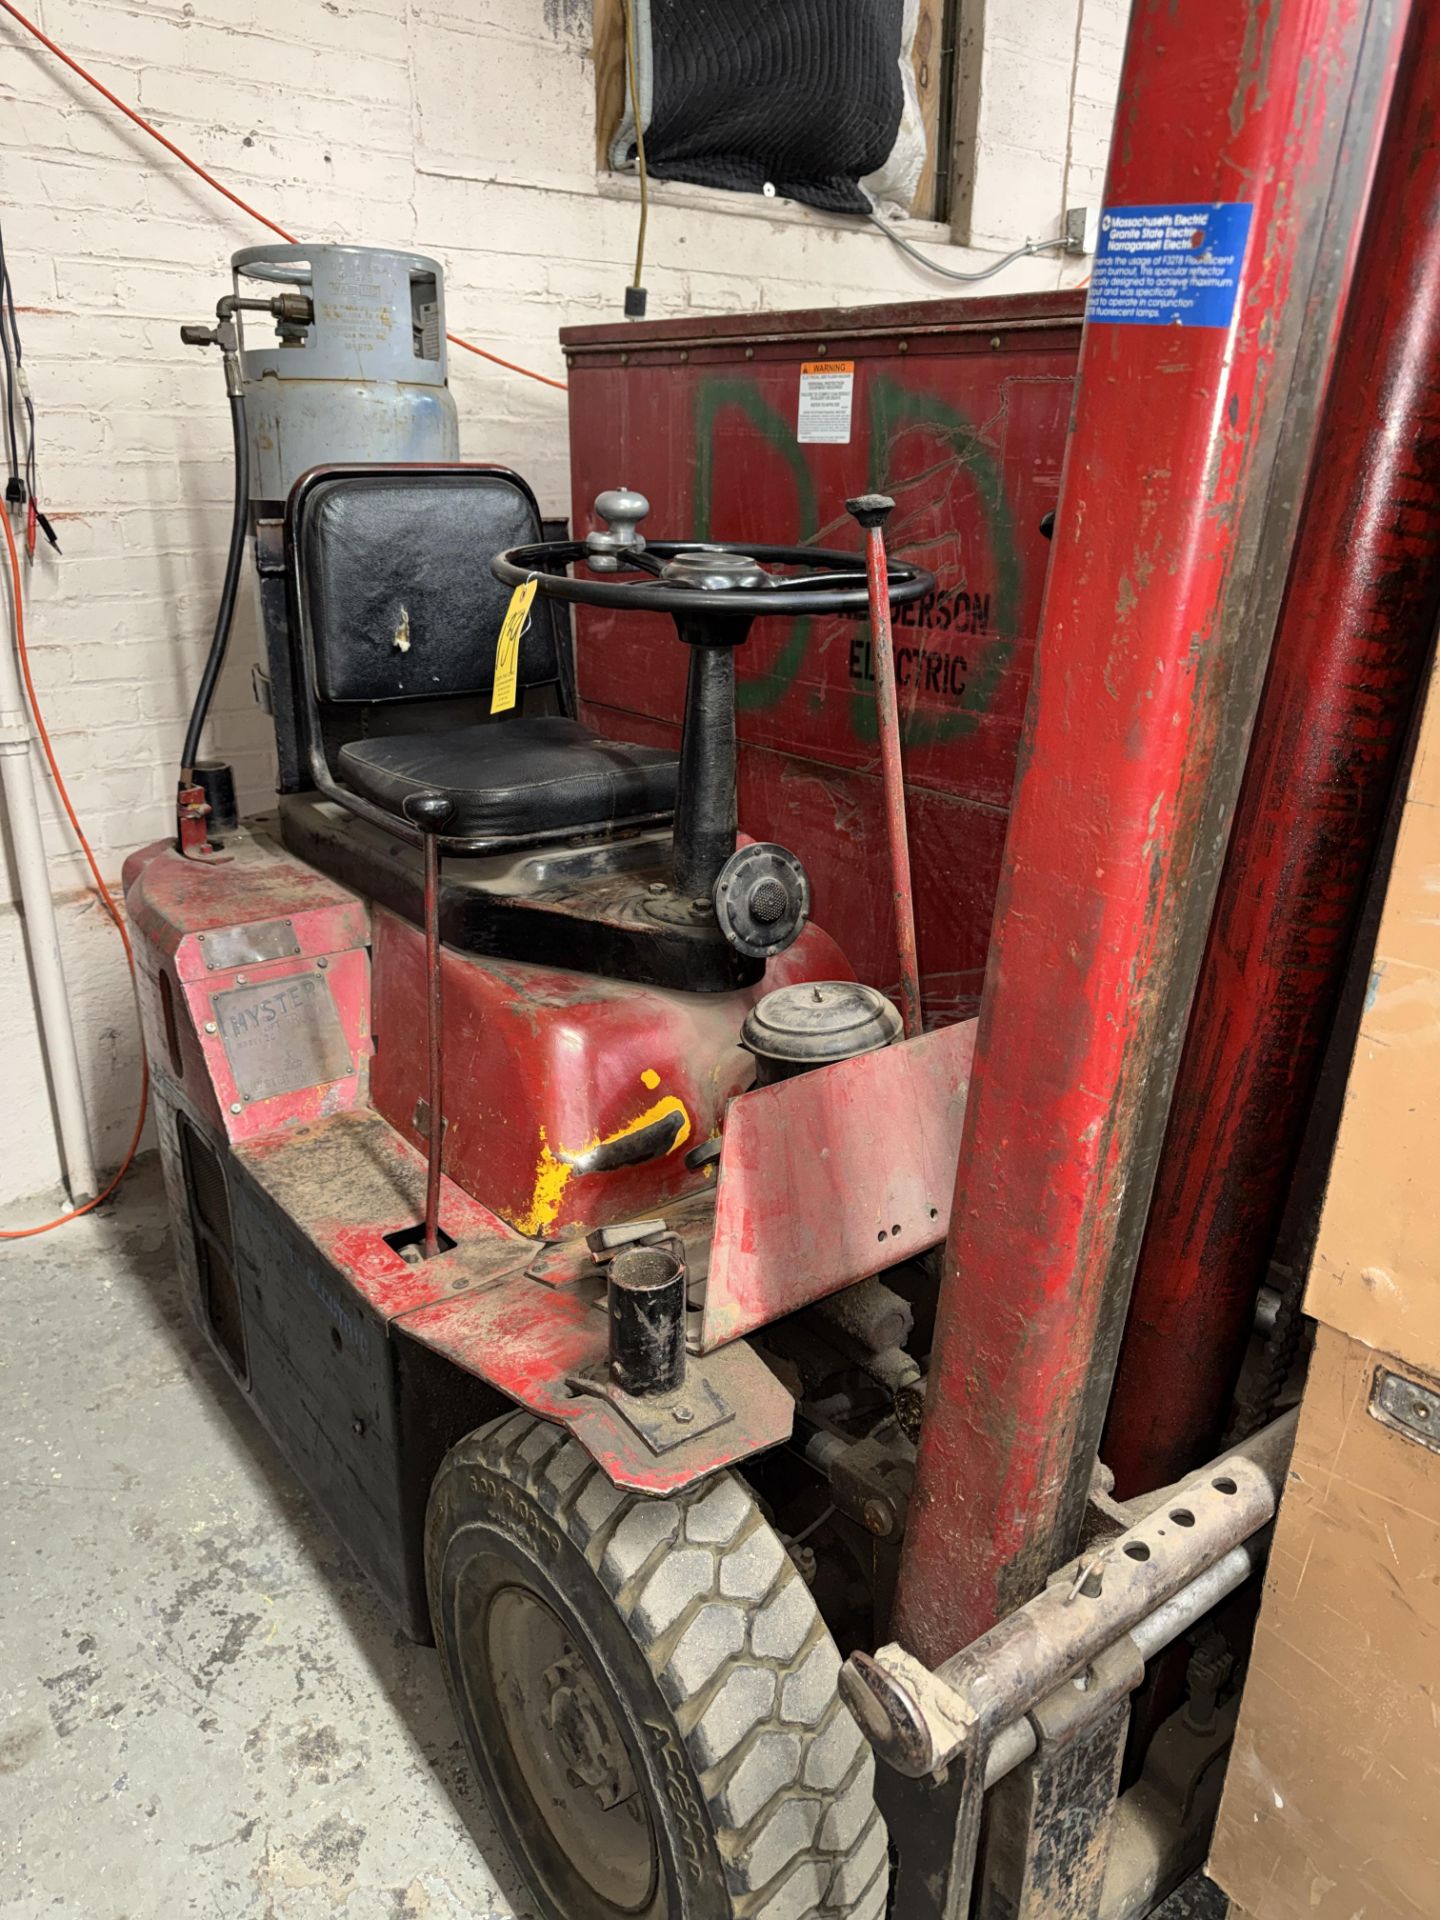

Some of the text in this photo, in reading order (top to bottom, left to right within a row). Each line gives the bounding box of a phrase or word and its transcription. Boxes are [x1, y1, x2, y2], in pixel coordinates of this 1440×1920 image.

[1112, 213, 1209, 227] Massachusetts Electric
[1109, 228, 1141, 239] Granite
[1141, 227, 1164, 239] State
[1107, 238, 1192, 253] Narragansett Electri
[1114, 256, 1127, 265] the
[1152, 255, 1162, 265] of
[1154, 267, 1188, 277] specular
[1110, 278, 1145, 288] designed
[1146, 278, 1154, 286] to
[1189, 278, 1233, 288] maximum
[1103, 288, 1119, 296] and
[1135, 288, 1178, 298] specifically
[1100, 298, 1107, 307] to
[1108, 298, 1138, 308] operate
[1138, 298, 1146, 307] in
[1147, 298, 1194, 309] conjunction
[1096, 307, 1136, 317] fluorescent
[813, 363, 846, 373] WARNING
[849, 638, 968, 697] ELCTRIC
